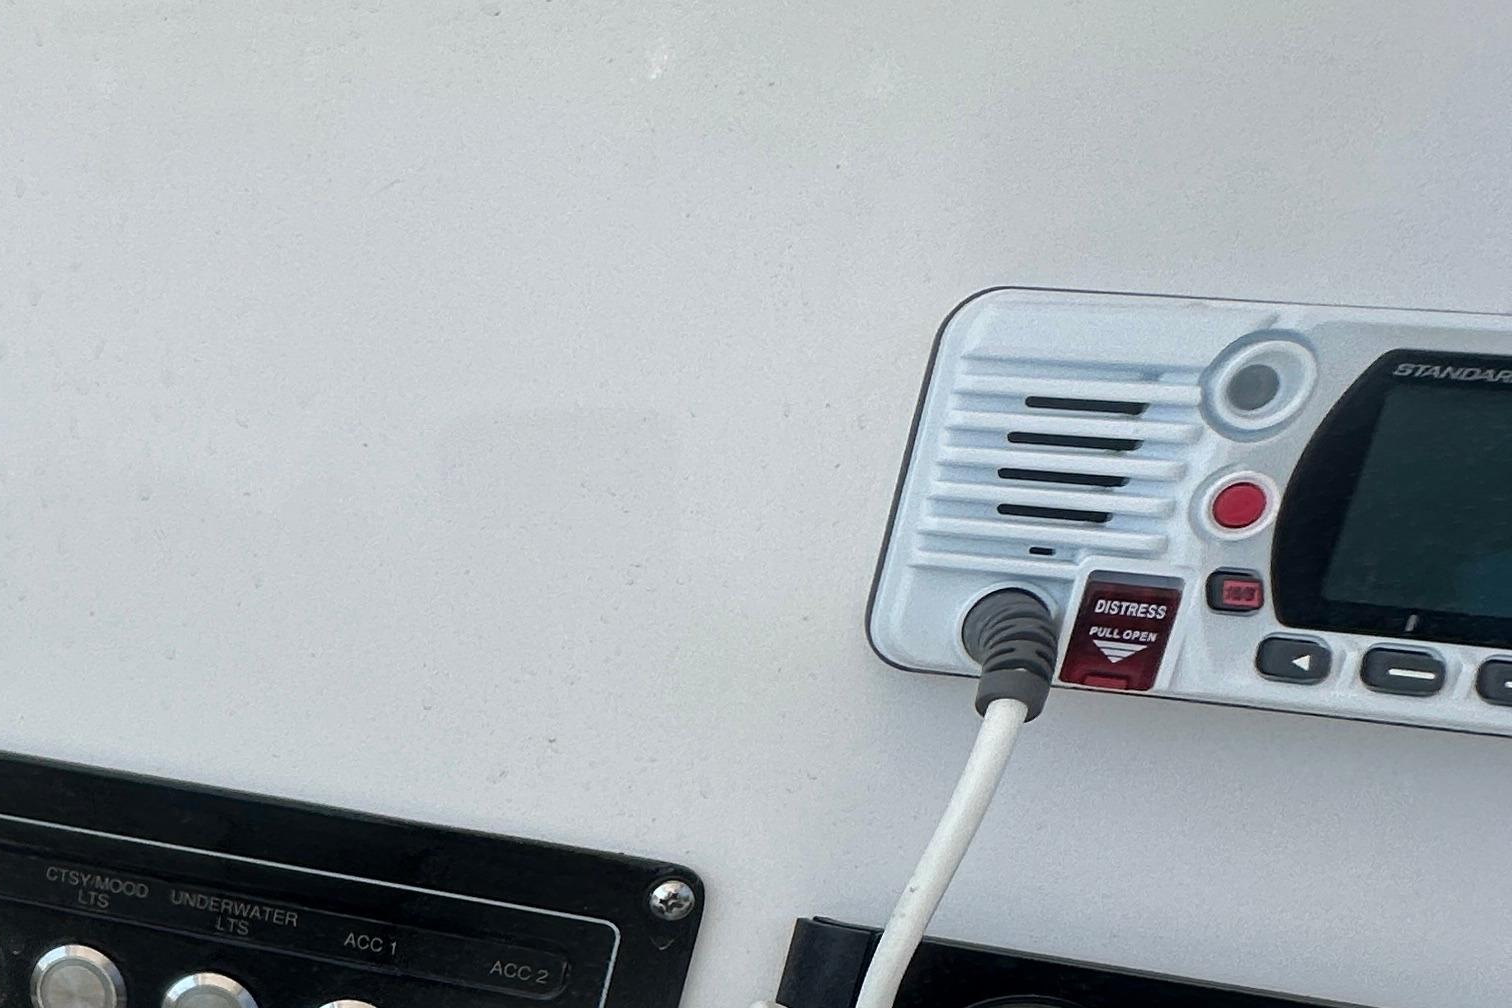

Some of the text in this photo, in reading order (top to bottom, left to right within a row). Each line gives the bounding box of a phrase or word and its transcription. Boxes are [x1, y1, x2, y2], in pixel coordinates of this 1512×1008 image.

[1094, 599, 1168, 620] DISTRESS
[1089, 626, 1158, 642] PULL OPEN
[45, 866, 150, 898] CTSY/MOOD
[77, 889, 110, 908] LTS
[169, 888, 300, 928] UNDERWATER
[215, 915, 250, 936] LTS
[343, 931, 398, 957] ACC 1
[489, 959, 551, 985] ACC 2
